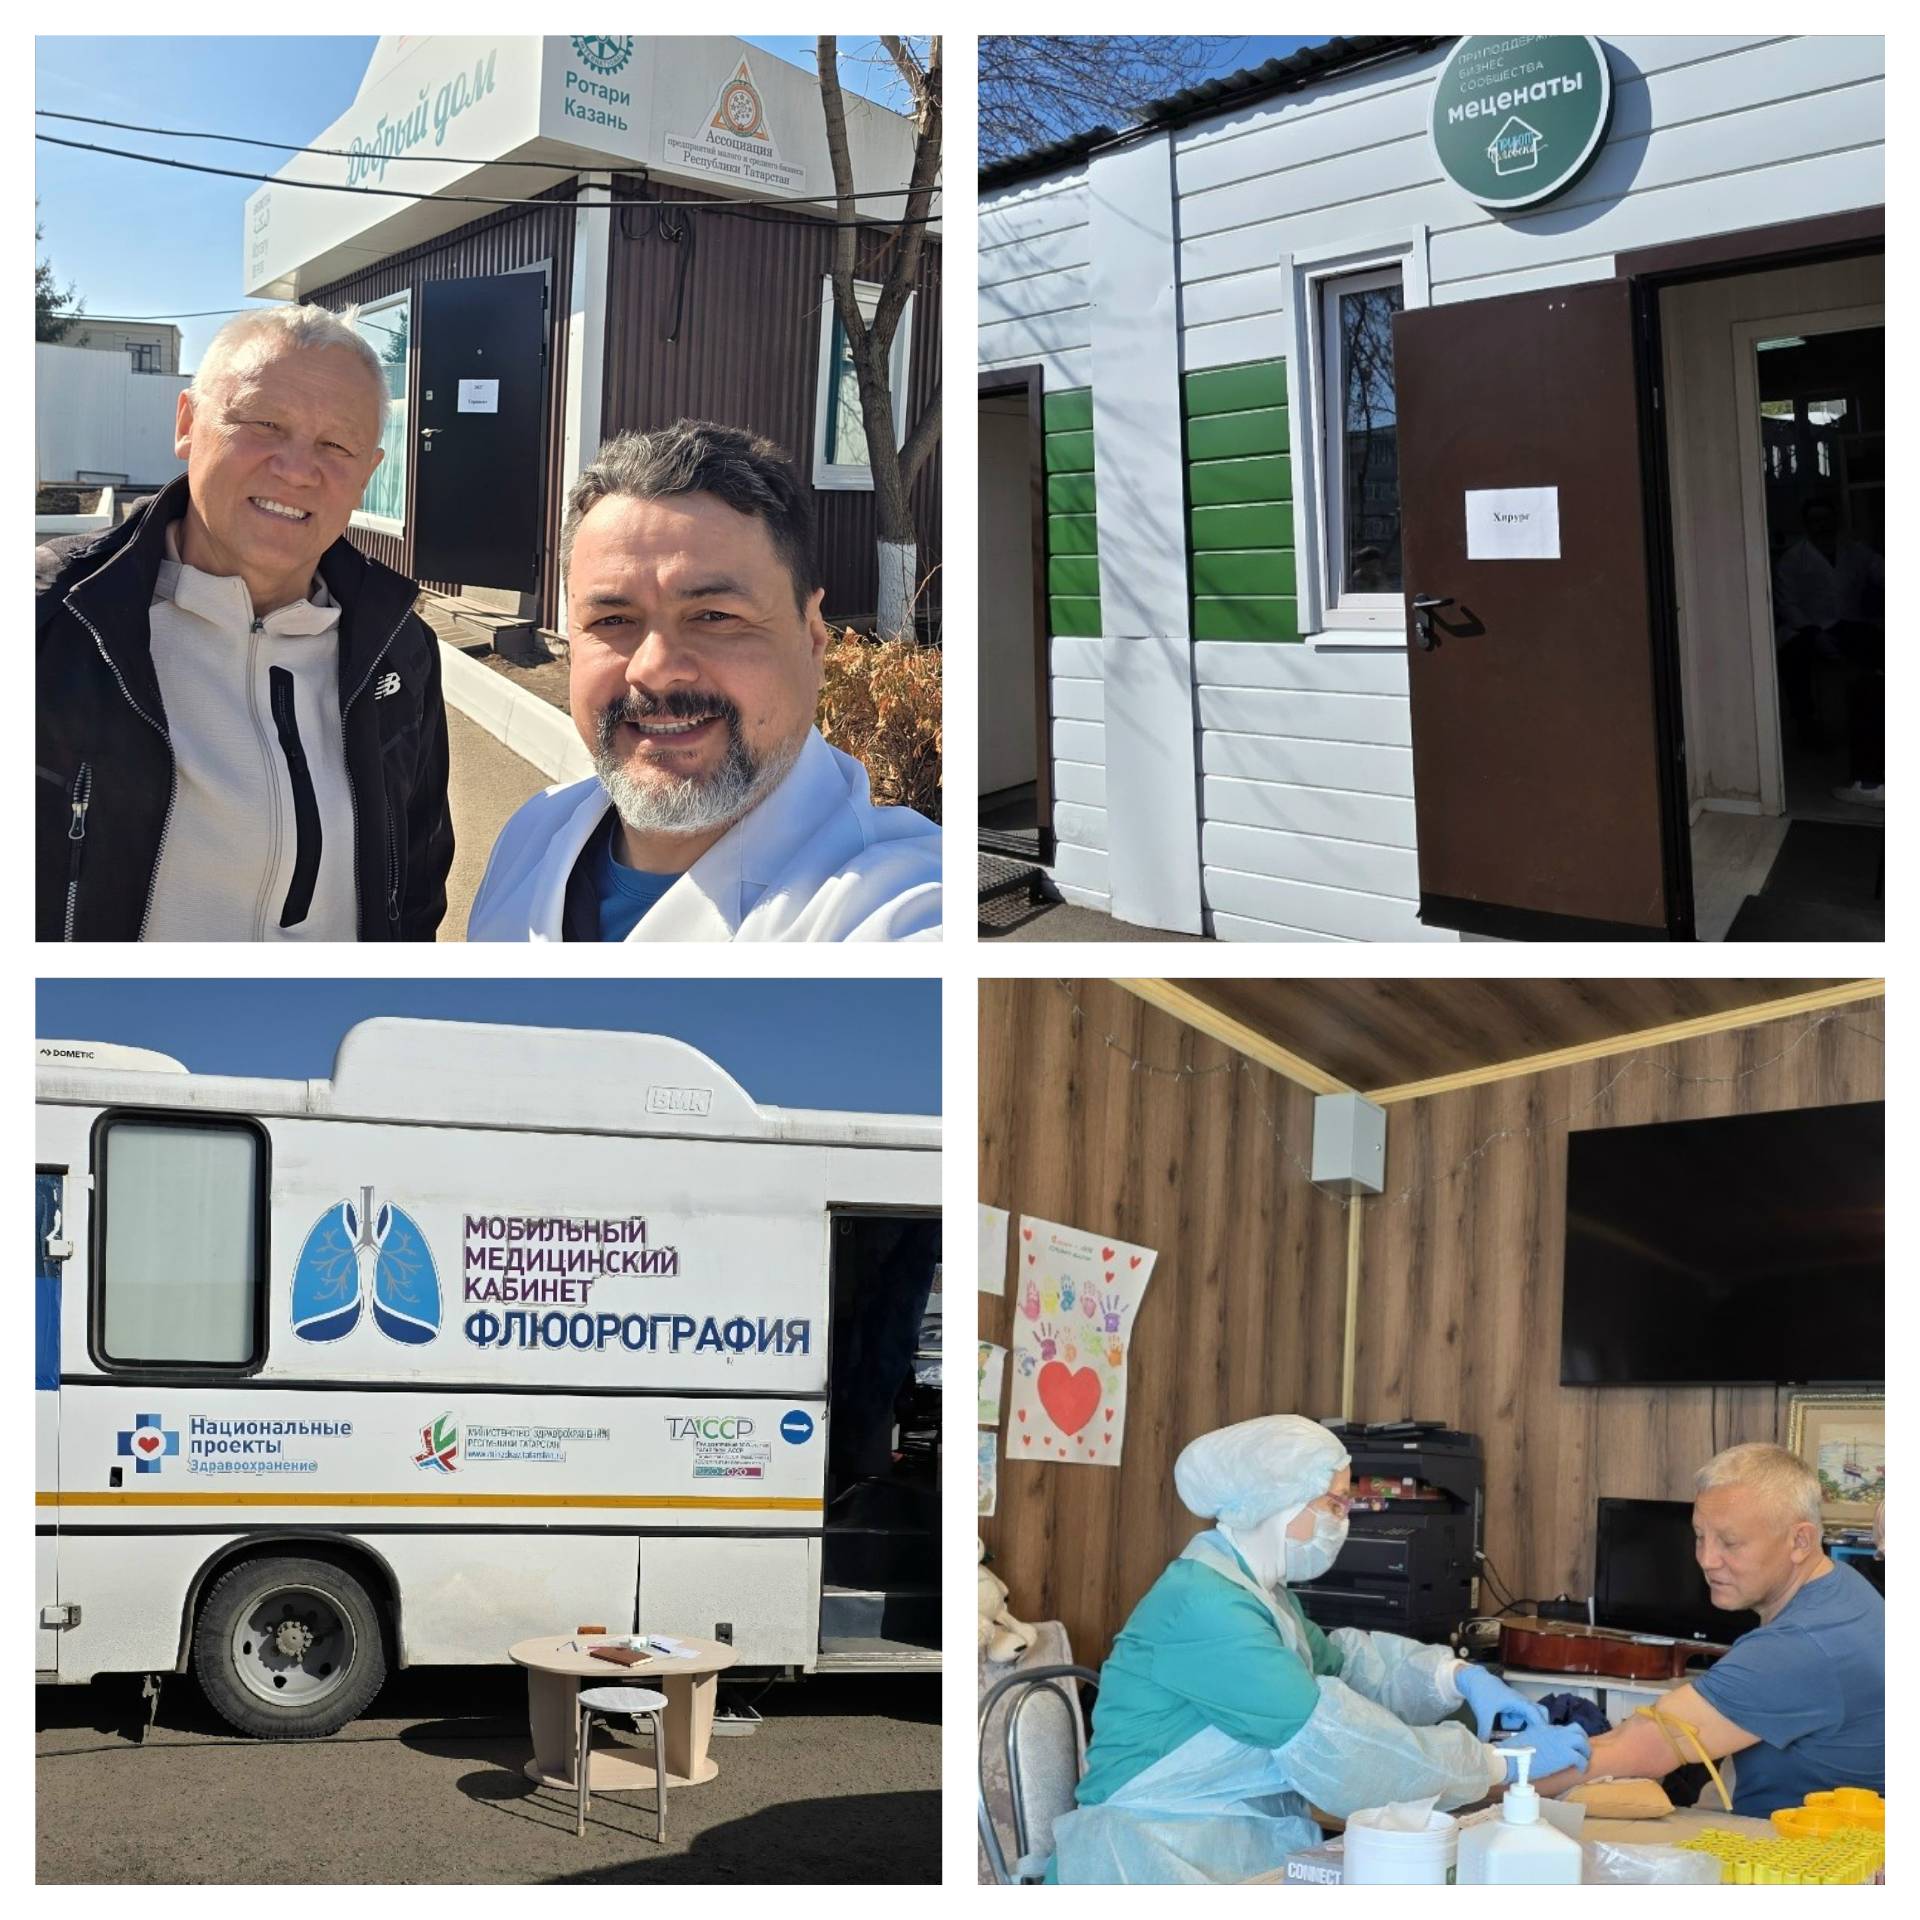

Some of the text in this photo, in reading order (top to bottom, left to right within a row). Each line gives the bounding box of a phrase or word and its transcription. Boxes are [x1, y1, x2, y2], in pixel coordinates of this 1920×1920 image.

[579, 41, 624, 66] INTERNATIONAL
[1459, 57, 1504, 79] БИЗНЕС
[1460, 61, 1544, 93] СООБЩЕСТВА
[566, 70, 630, 106] Ротари
[1448, 71, 1583, 124] меценаты
[346, 47, 497, 187] Добрый дом
[565, 97, 628, 131] Казань
[667, 138, 716, 155] предприятий
[717, 148, 742, 161] малого
[749, 157, 778, 170] среднего
[779, 162, 804, 176] бизнеса
[706, 130, 773, 157] Ассоциация
[683, 150, 790, 185] Республики Татарстан
[1493, 512, 1530, 523] Хирург
[52, 1049, 94, 1059] DOMETIC
[465, 1215, 647, 1243] МОБИЛЬНЫЙ
[465, 1245, 678, 1277] МЕДИЦИНСКИЙ
[465, 1277, 593, 1303] КАБИНЕТ
[464, 1310, 811, 1354] ФЛЮОРОГРАФИЯ
[191, 1417, 352, 1437] Национальные
[191, 1439, 282, 1457] проекты
[191, 1459, 317, 1473] Здравоохранение
[1287, 1861, 1342, 1885] CONNECT
